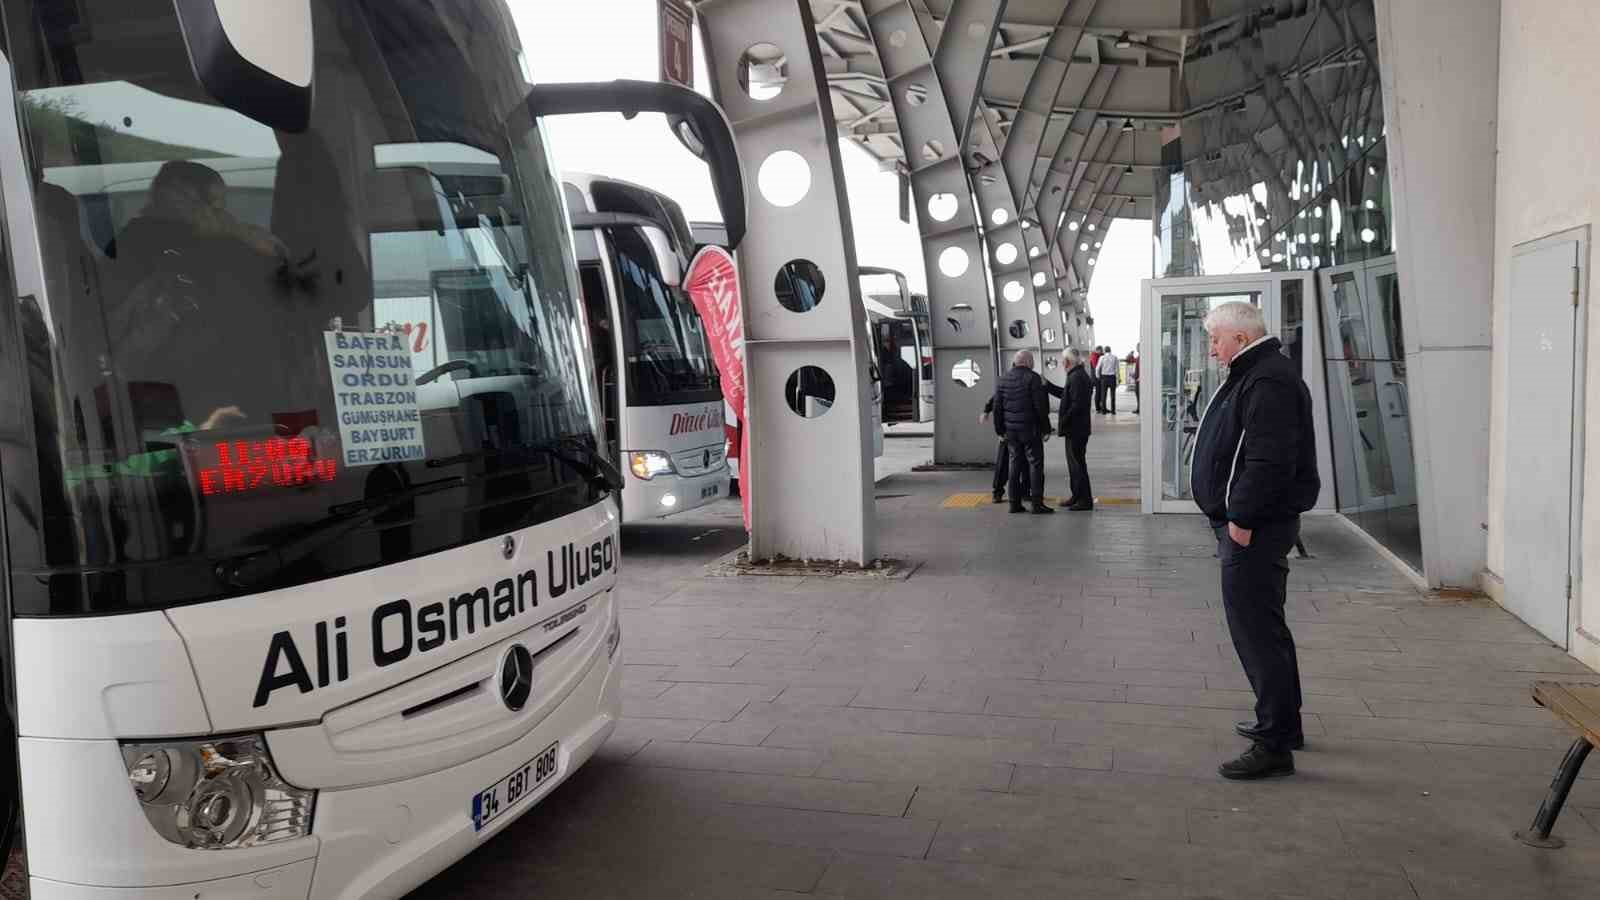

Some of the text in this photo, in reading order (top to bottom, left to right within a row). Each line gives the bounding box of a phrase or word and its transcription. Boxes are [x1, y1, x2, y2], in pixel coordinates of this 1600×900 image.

[336, 333, 402, 351] BAFRA
[333, 354, 412, 369] SAMSUN
[343, 373, 408, 387] ORDU
[338, 391, 417, 407] TRABZON
[351, 427, 416, 444] BAYBURT
[347, 445, 424, 464] ERZURUM
[252, 614, 350, 709] Ali
[371, 567, 539, 668] Osman
[481, 788, 499, 820] 34
[536, 747, 556, 783] 808
